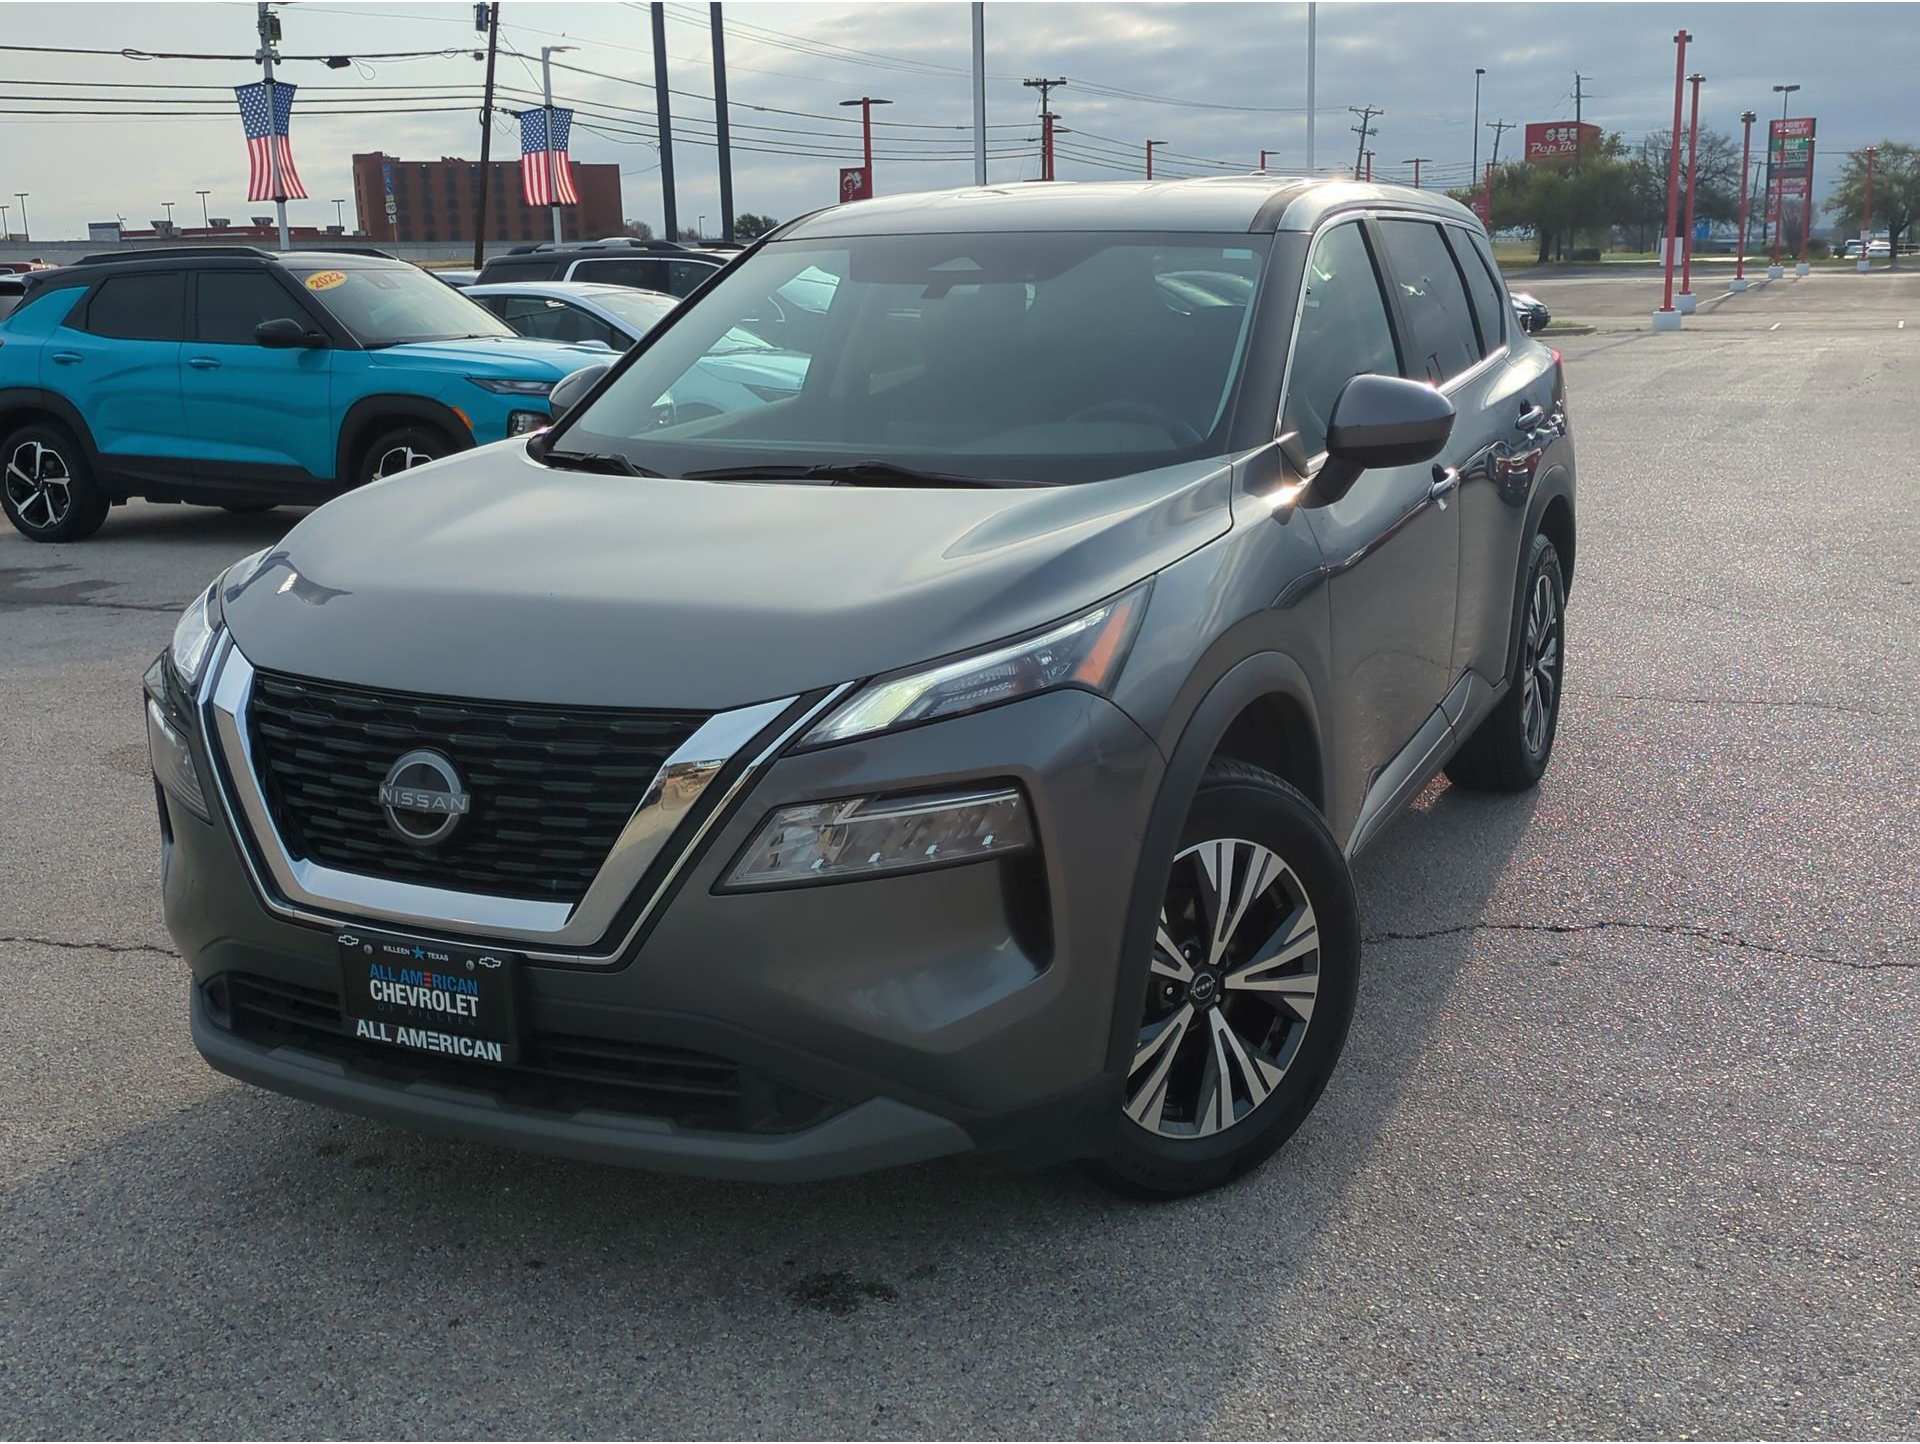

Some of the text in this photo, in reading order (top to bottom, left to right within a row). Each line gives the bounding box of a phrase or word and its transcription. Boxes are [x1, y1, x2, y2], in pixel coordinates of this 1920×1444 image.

[310, 271, 344, 289] 2022
[381, 786, 467, 811] NISSAN
[427, 951, 449, 962] TEXAS
[370, 963, 479, 995] ALL AMERICAN
[370, 979, 479, 1017] CHEVROLET
[356, 1019, 503, 1062] ALL AMERICAN
